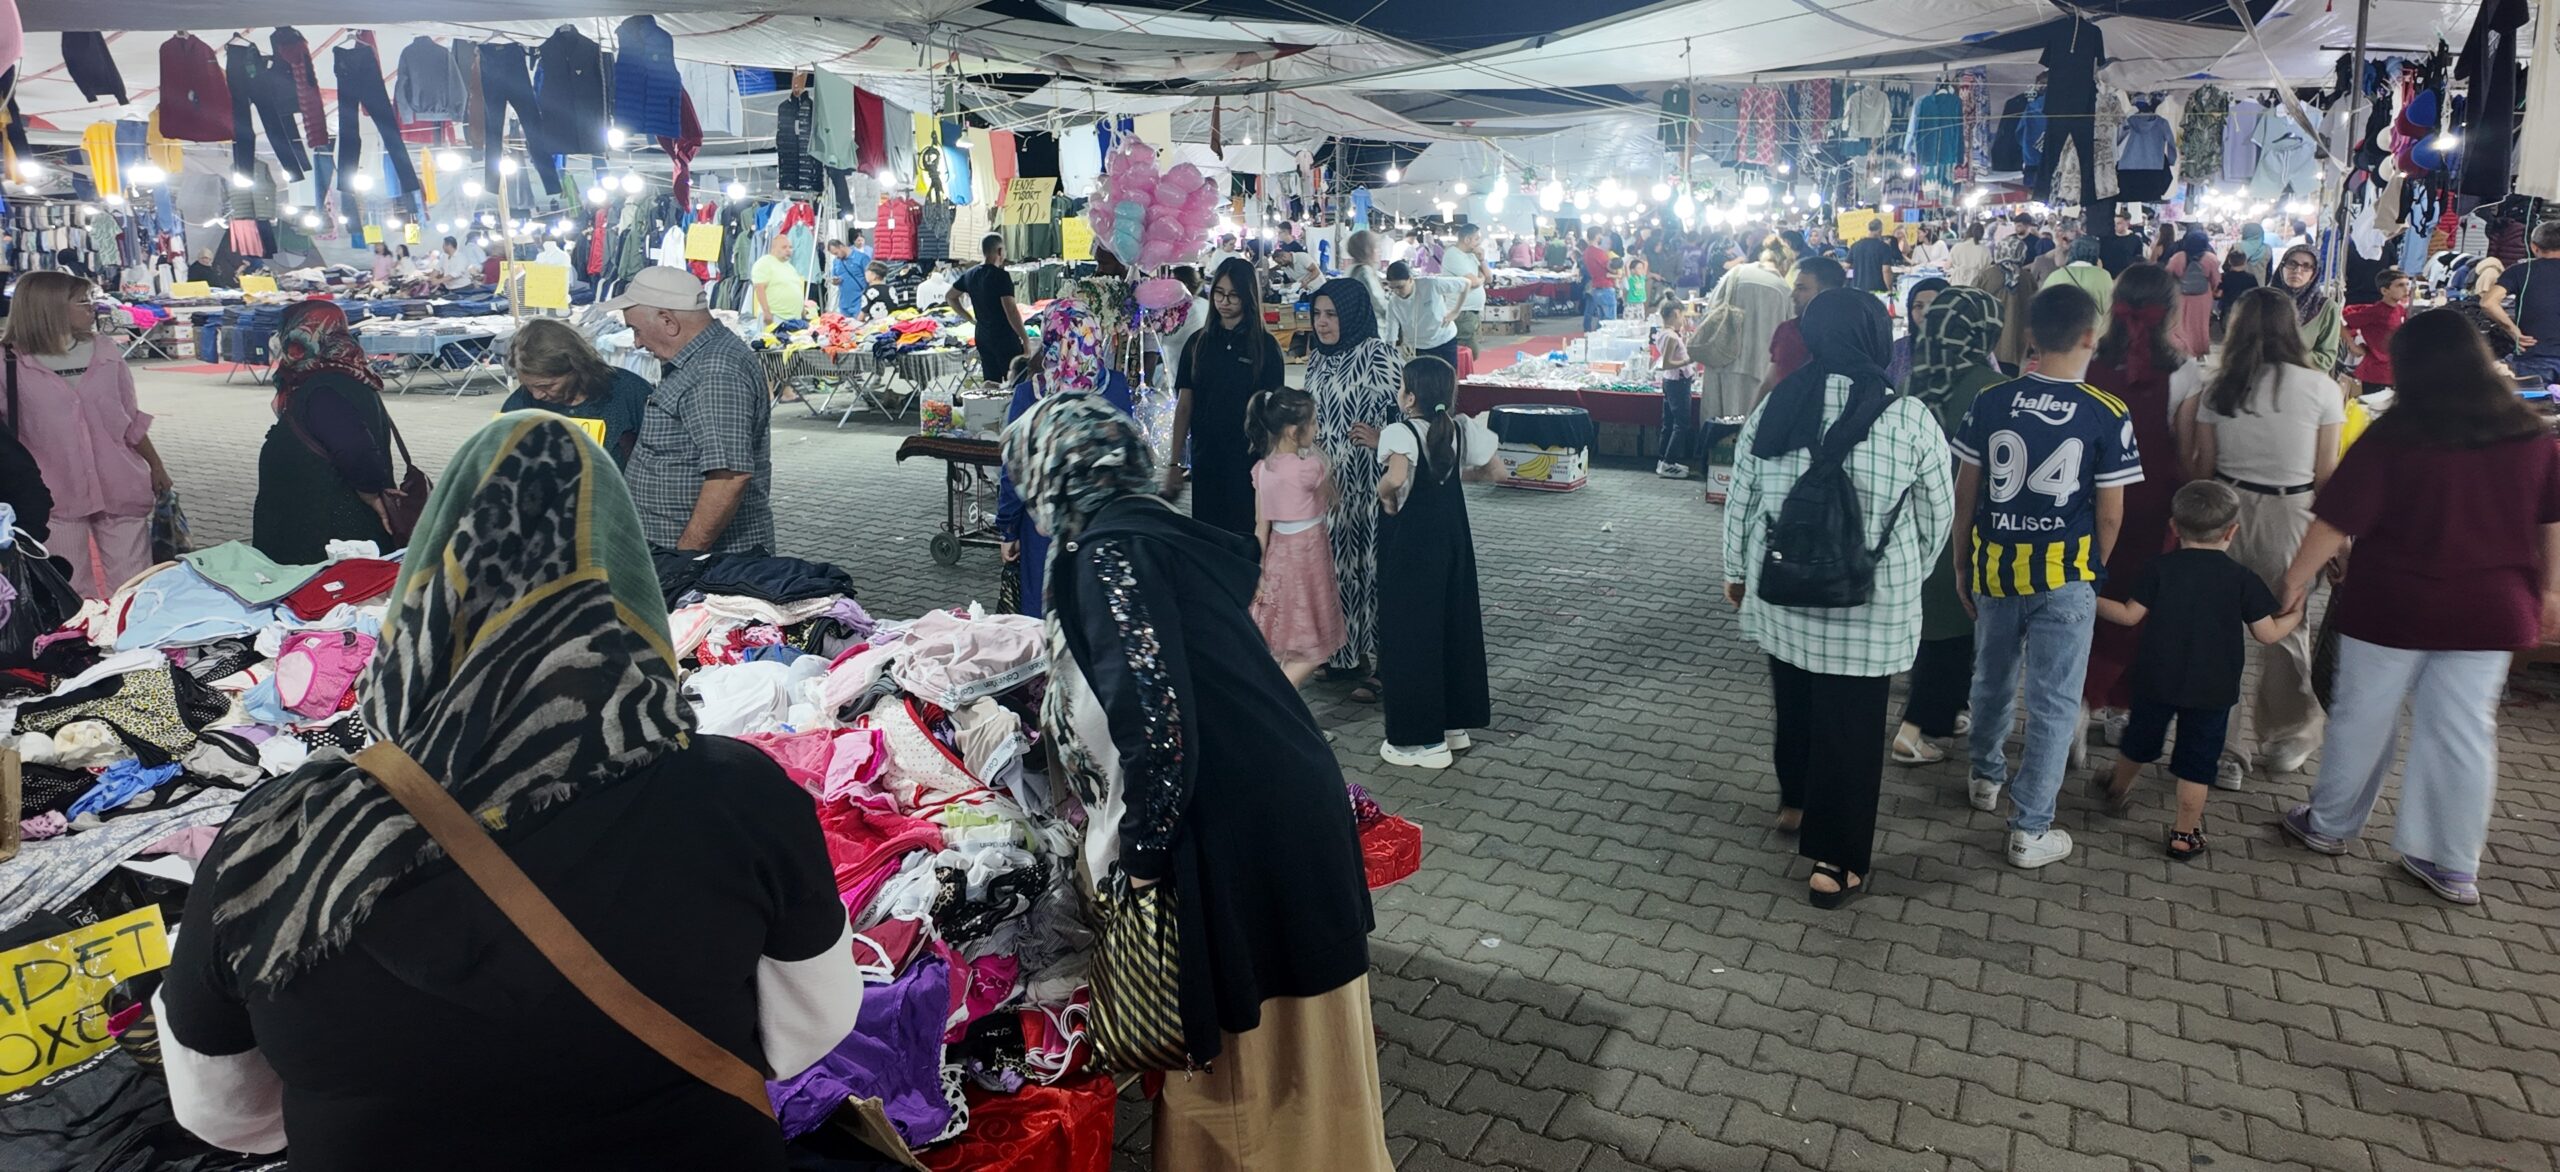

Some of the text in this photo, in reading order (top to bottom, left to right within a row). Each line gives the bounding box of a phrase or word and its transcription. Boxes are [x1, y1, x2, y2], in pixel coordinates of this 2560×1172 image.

[1016, 202, 1039, 224] 100
[2010, 391, 2078, 425] halley
[1988, 429, 2084, 507] 94
[1990, 511, 2067, 532] TALISCA
[41, 1059, 99, 1087] Calvin
